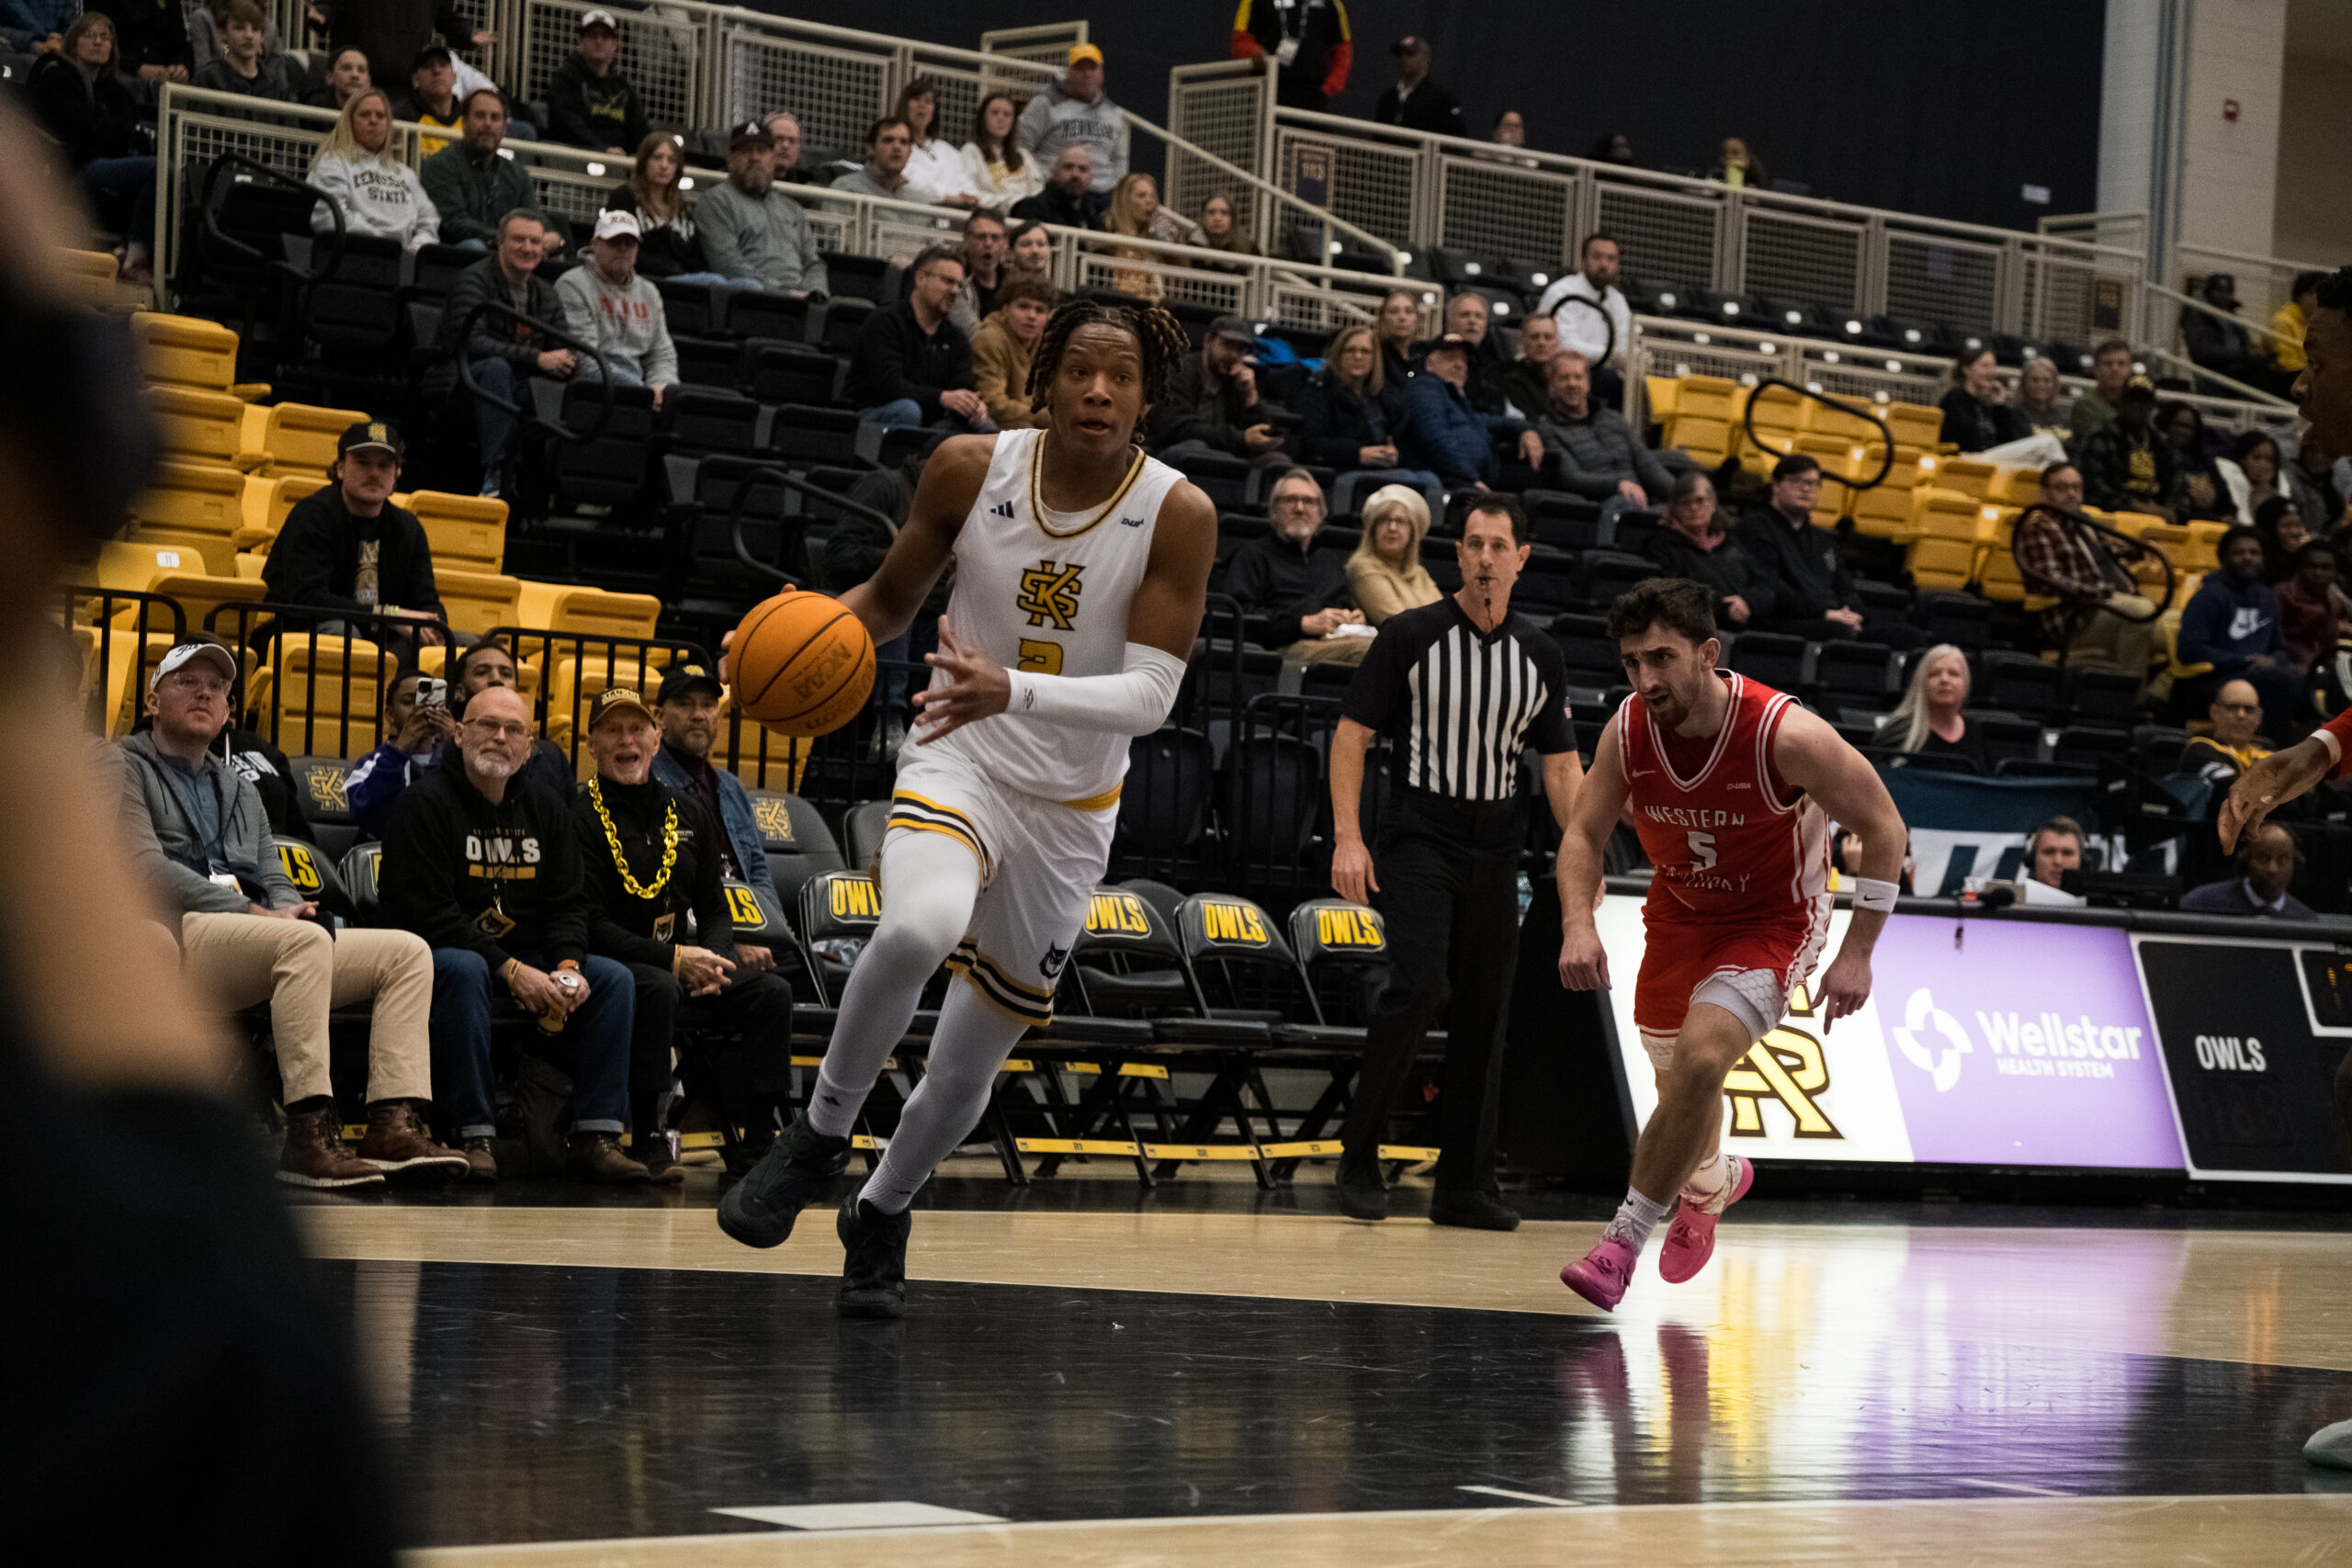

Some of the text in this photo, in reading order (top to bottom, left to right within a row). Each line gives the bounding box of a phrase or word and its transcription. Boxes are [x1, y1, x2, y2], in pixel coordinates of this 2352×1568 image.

[1645, 805, 1745, 828] WESTERN
[279, 846, 320, 888] LS
[1687, 830, 1718, 873] 5
[724, 887, 764, 924] LS
[831, 879, 881, 917] OWL
[1086, 895, 1148, 932] OWLS
[1204, 903, 1268, 942] OWLS
[1318, 908, 1382, 946] OWLS
[1975, 1010, 2143, 1060] Wellstar
[2195, 1034, 2267, 1072] OWLS
[1996, 1057, 2115, 1079] HEALTH SYSTEM
